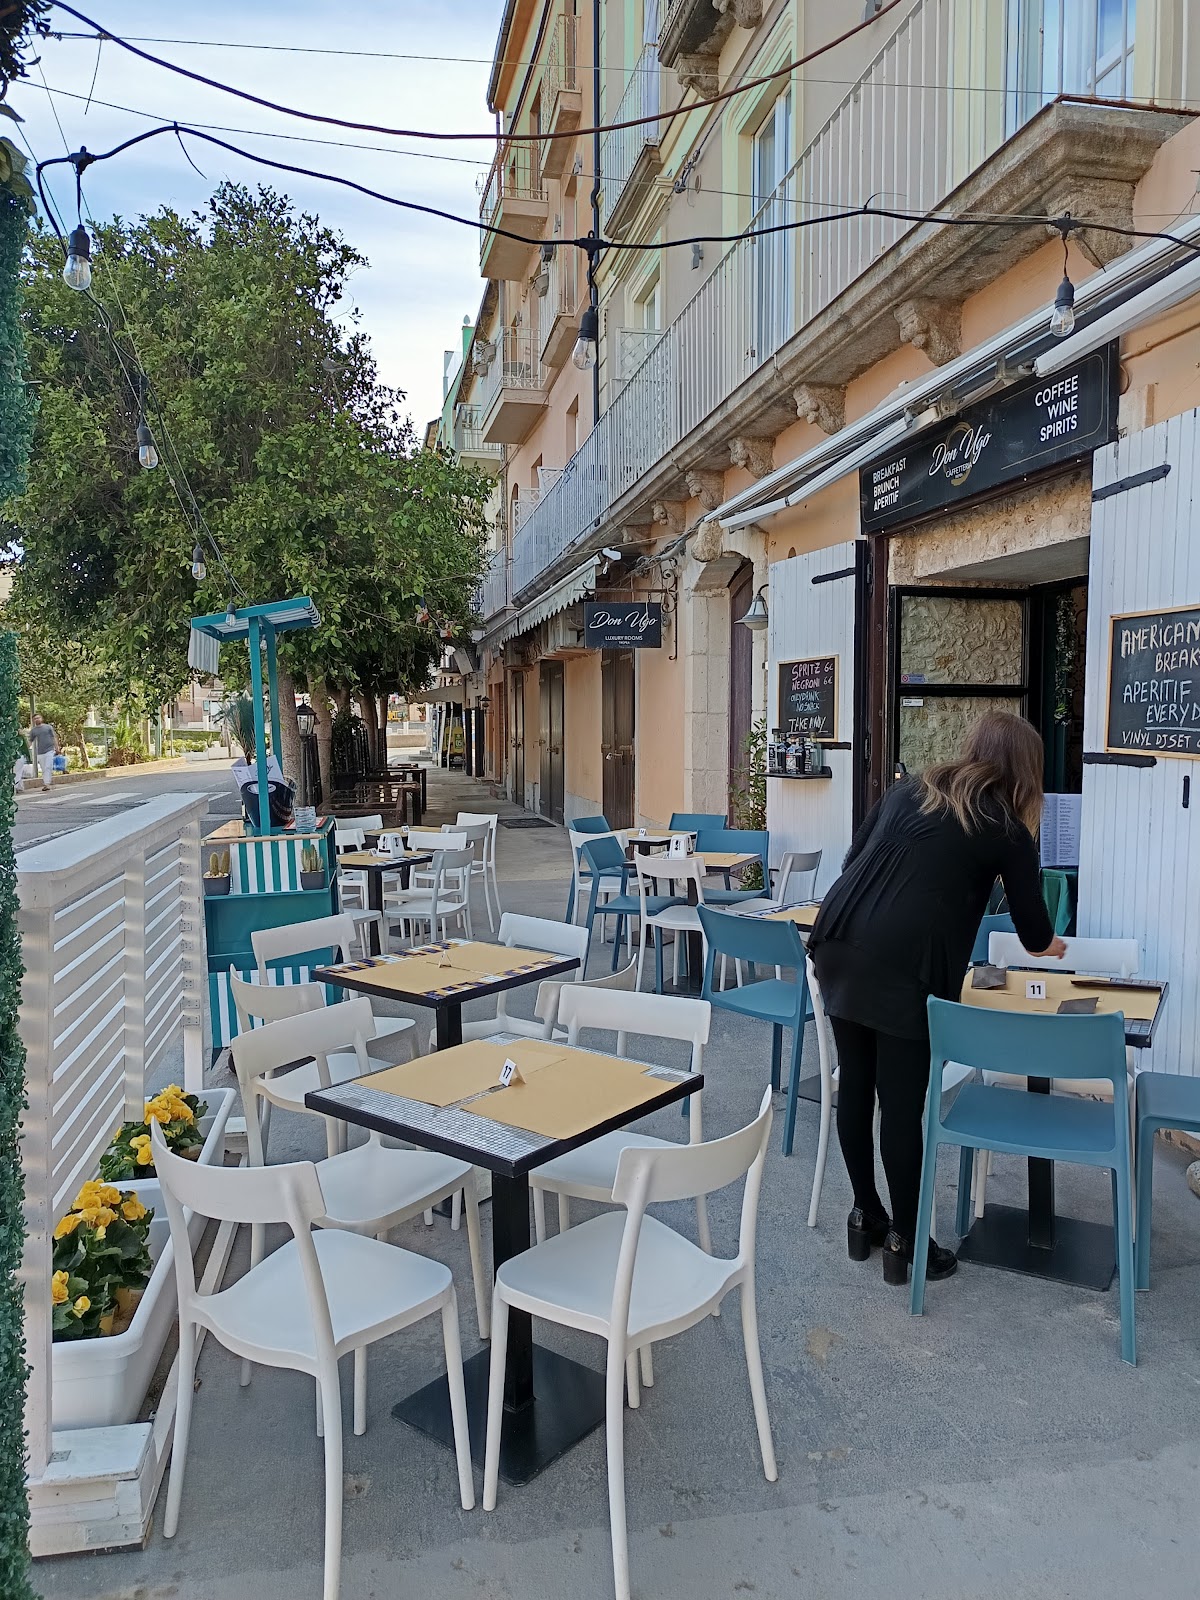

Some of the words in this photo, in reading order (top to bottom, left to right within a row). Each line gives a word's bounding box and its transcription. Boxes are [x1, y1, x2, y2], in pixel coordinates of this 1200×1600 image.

[1035, 374, 1079, 407] COFFEE
[1047, 395, 1078, 420] WINE
[1040, 414, 1078, 442] SPIRITS
[929, 442, 958, 476] Don
[960, 424, 993, 464] Ugo
[873, 457, 907, 483] BREAKFAST
[945, 461, 973, 478] CAFFETTERIA
[873, 476, 900, 497] BRUNCH
[873, 490, 899, 511] APERITIF
[589, 611, 623, 629] Don
[624, 611, 658, 633] Ugo
[792, 663, 820, 681] SPRITZ
[792, 678, 820, 691] NEGRONI
[1123, 679, 1192, 704] APERITIF
[788, 717, 808, 732] TAKE
[1122, 729, 1151, 746] VINYL
[1030, 984, 1042, 995] 11
[502, 1065, 512, 1079] 17
